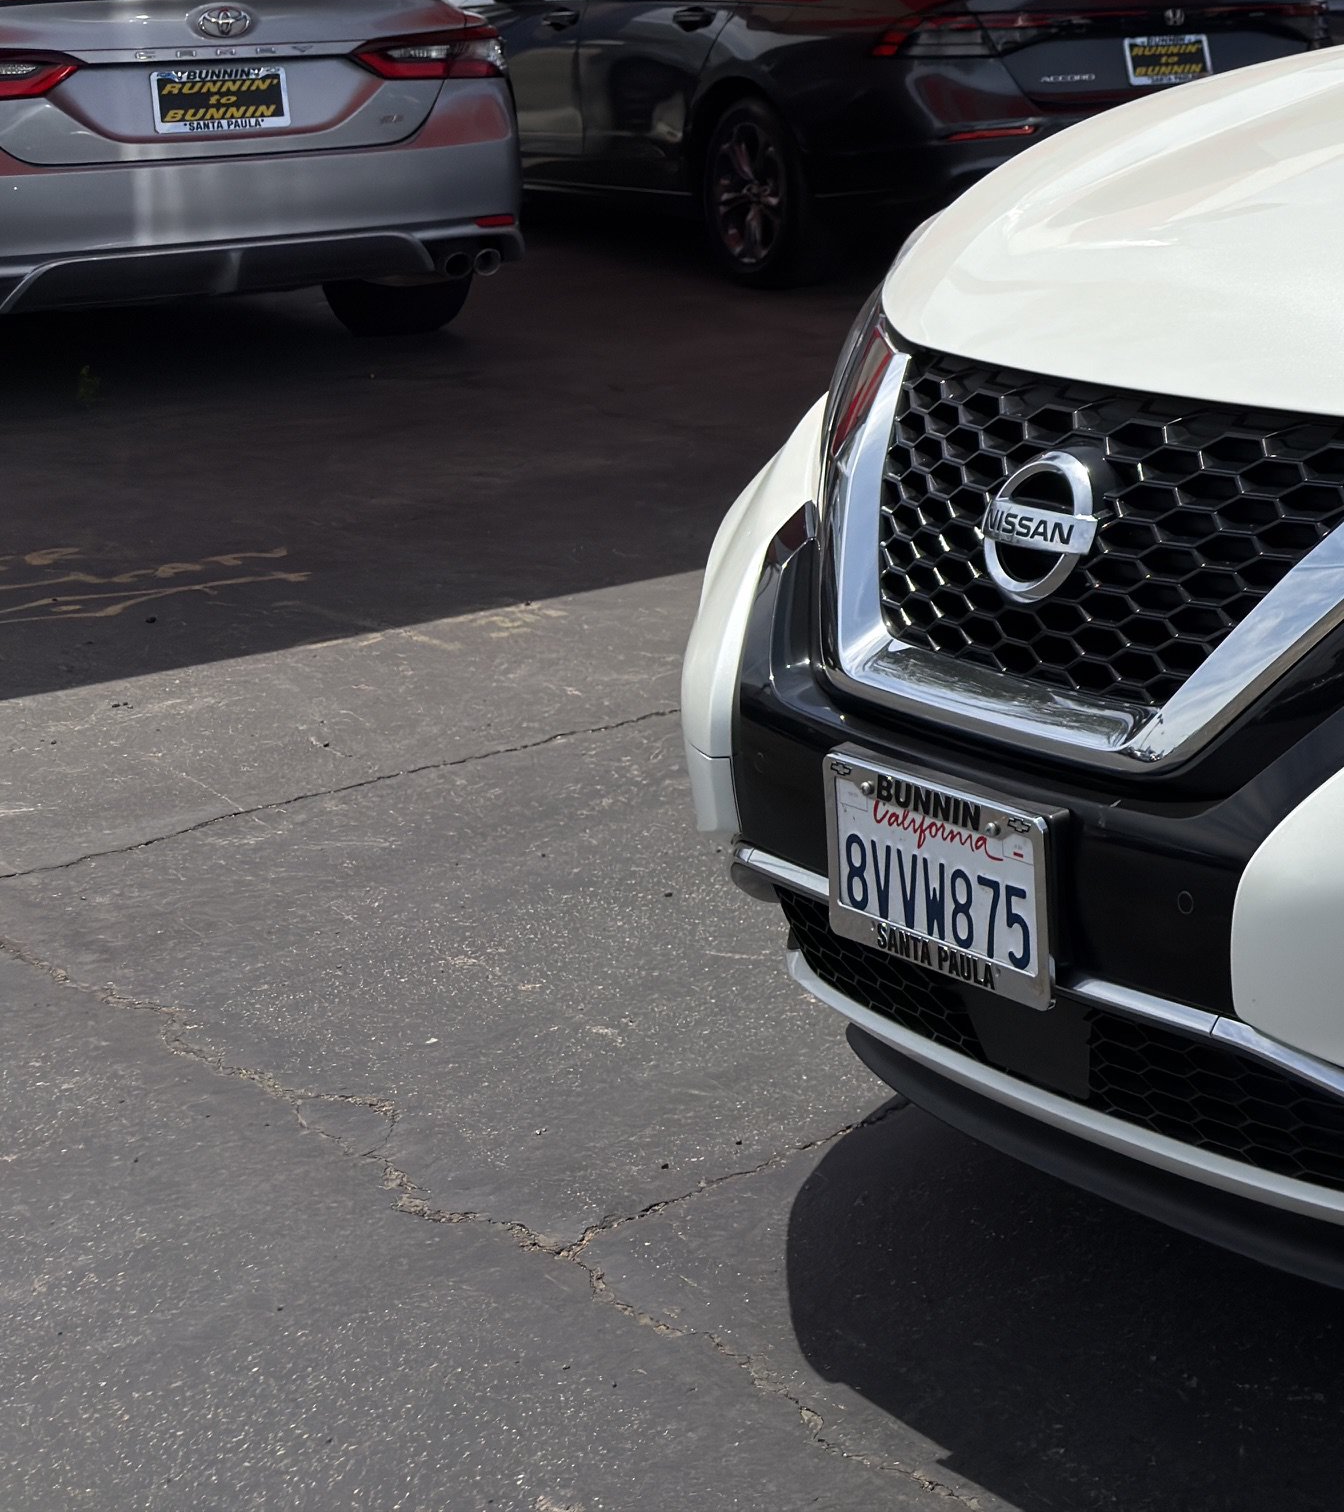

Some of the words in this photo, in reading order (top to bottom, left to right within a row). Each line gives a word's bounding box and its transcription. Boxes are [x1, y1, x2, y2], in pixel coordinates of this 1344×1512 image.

[186, 68, 251, 81] BUNNIN
[1040, 73, 1096, 83] ACCORD
[1135, 63, 1203, 76] BUNNIN
[208, 93, 238, 105] to
[164, 104, 276, 122] BUNNIN
[187, 119, 225, 131] SANTA
[226, 117, 263, 129] PAULA
[984, 508, 1074, 545] NISSAN
[874, 773, 982, 832] BUNNIN
[873, 799, 1004, 862] California
[845, 832, 1031, 970] 8VVW875
[876, 922, 932, 967] SANTA
[937, 945, 996, 991] PAULA
